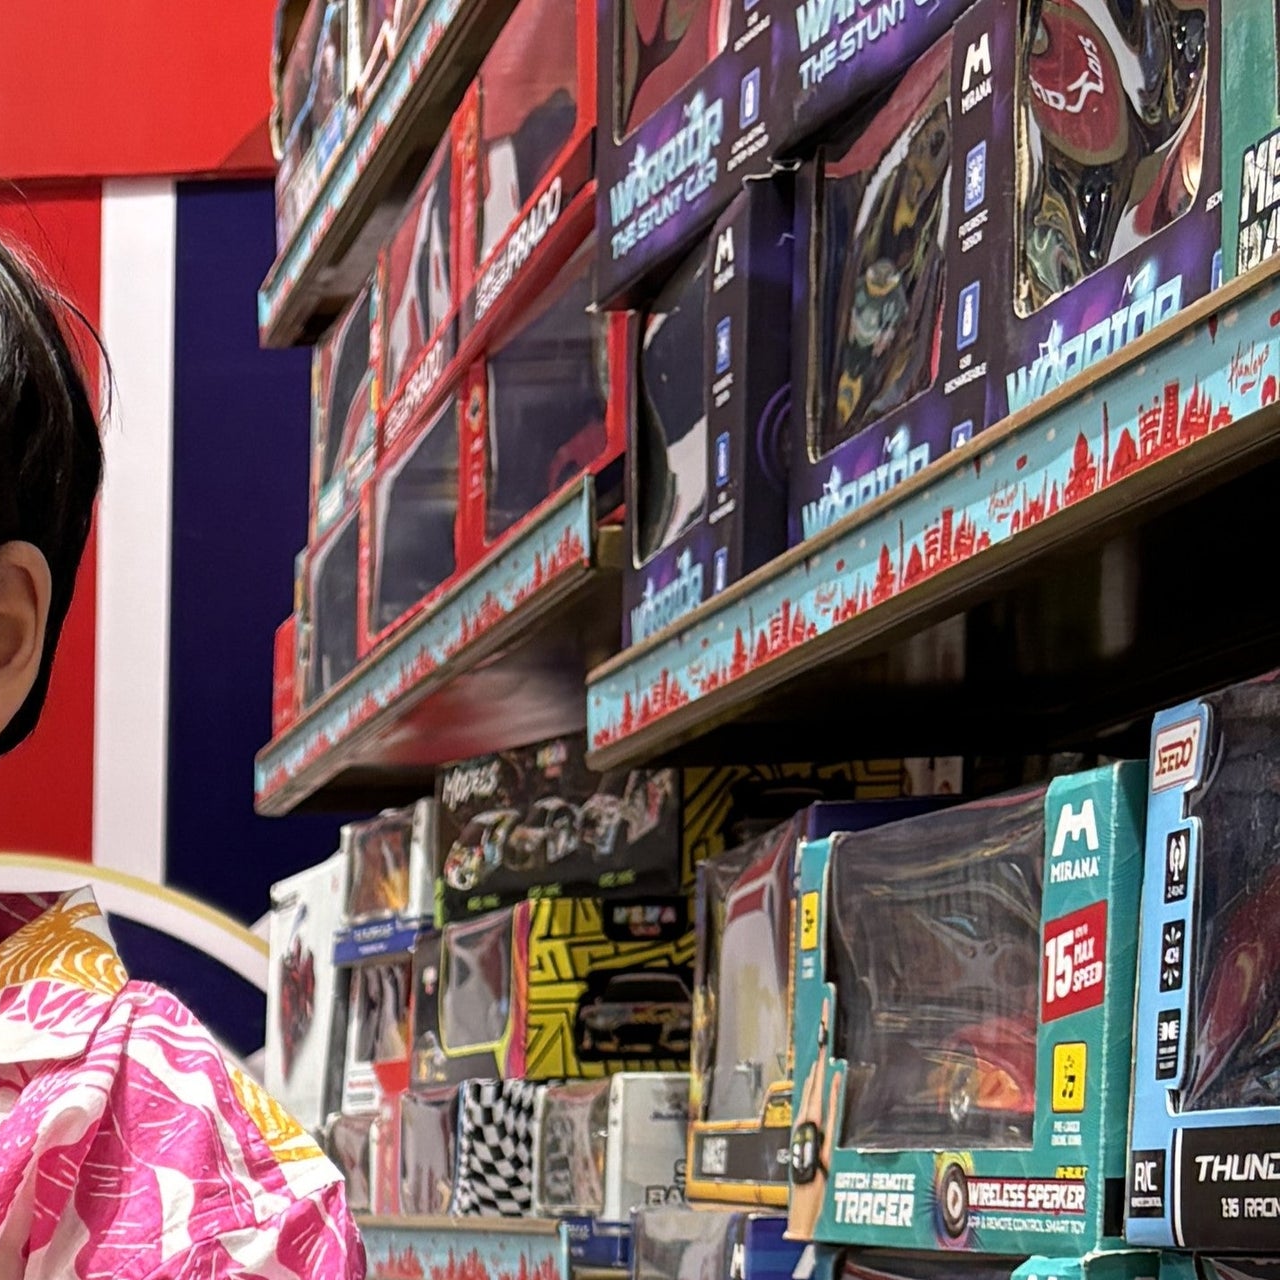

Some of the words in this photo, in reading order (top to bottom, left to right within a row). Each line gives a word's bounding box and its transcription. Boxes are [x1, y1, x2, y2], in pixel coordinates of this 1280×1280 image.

[799, 39, 839, 90] THE
[1050, 856, 1100, 883] MIRANA
[1043, 929, 1074, 1003] 15
[1073, 937, 1095, 966] MAX
[1072, 960, 1103, 994] SPEED
[872, 1173, 916, 1191] REMOTE
[967, 1181, 1026, 1208] WIRELESS
[1028, 1183, 1086, 1210] SPEAKER
